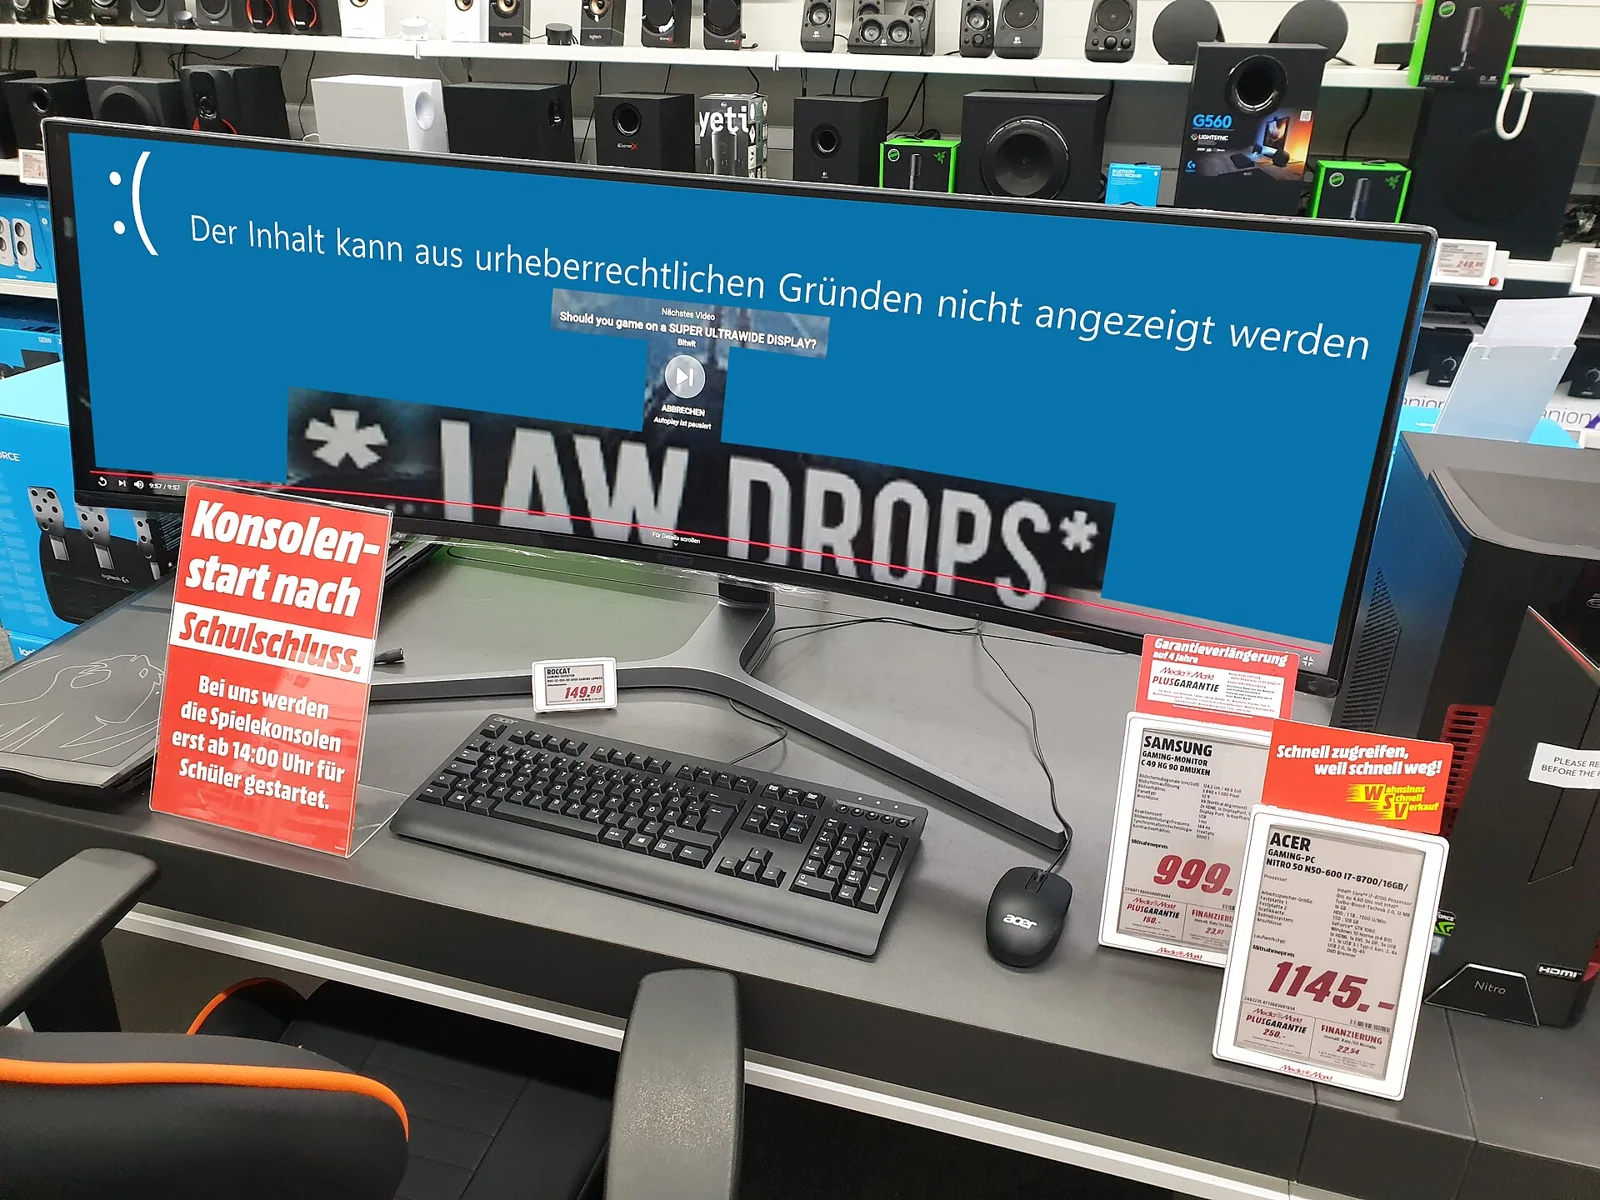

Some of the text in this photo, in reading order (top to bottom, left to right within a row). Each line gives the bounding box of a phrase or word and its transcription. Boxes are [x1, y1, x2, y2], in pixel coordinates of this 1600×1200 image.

[699, 106, 749, 137] yeti
[1192, 114, 1233, 129] G560
[191, 215, 1369, 361] Der Inhalt kann aus urheberrechtlichen Gründen nicht angezeigt werden
[661, 307, 715, 321] Nächstes Video
[560, 311, 817, 350] Should you game on a SUPER ULTRAWIDE DISPLAY?
[661, 404, 705, 417] ABBRECHEN
[654, 416, 679, 427] Autoplay
[191, 499, 380, 565] Konsolen-
[185, 555, 361, 617] start nach
[179, 612, 361, 674] Schulschluss.
[1152, 650, 1199, 664] auf 4 Jahre
[1153, 637, 1288, 668] Garantieverlängerung
[546, 667, 570, 675] ROCCAT
[564, 684, 602, 698] 149.99
[1151, 675, 1219, 692] PLUSGARANTIE
[198, 675, 329, 720] Bei uns werden
[181, 701, 341, 753] die Spielekonsolen
[1143, 735, 1213, 757] SAMSUNG
[1276, 745, 1409, 761] Schnell zugreifen,
[172, 730, 345, 783] erst ab 14:00 Uhr für
[1141, 750, 1208, 766] GAMING-MONITOR
[1554, 757, 1587, 767] PLEASE
[1157, 761, 1167, 769] HG
[1168, 763, 1178, 771] 90
[1314, 760, 1443, 777] weil schnell weg!
[1541, 764, 1577, 776] BEFORE
[179, 758, 329, 810] Schüler gestartet.
[1269, 831, 1311, 852] ACER
[1267, 848, 1315, 864] GAMING-PC
[1266, 857, 1408, 892] NITRO 50 N50-600 I7-8700/16GB/
[1126, 902, 1180, 918] PLUSGARANTIE
[1191, 908, 1233, 922] FINANZIERU
[1003, 914, 1037, 929] acer
[1539, 966, 1577, 978] HDMI
[1268, 960, 1395, 1012] 1145.-
[1474, 981, 1506, 995] Nitro
[1245, 1013, 1307, 1034] PLUSGARANTIE
[1320, 1023, 1383, 1045] FINANZIERUNG
